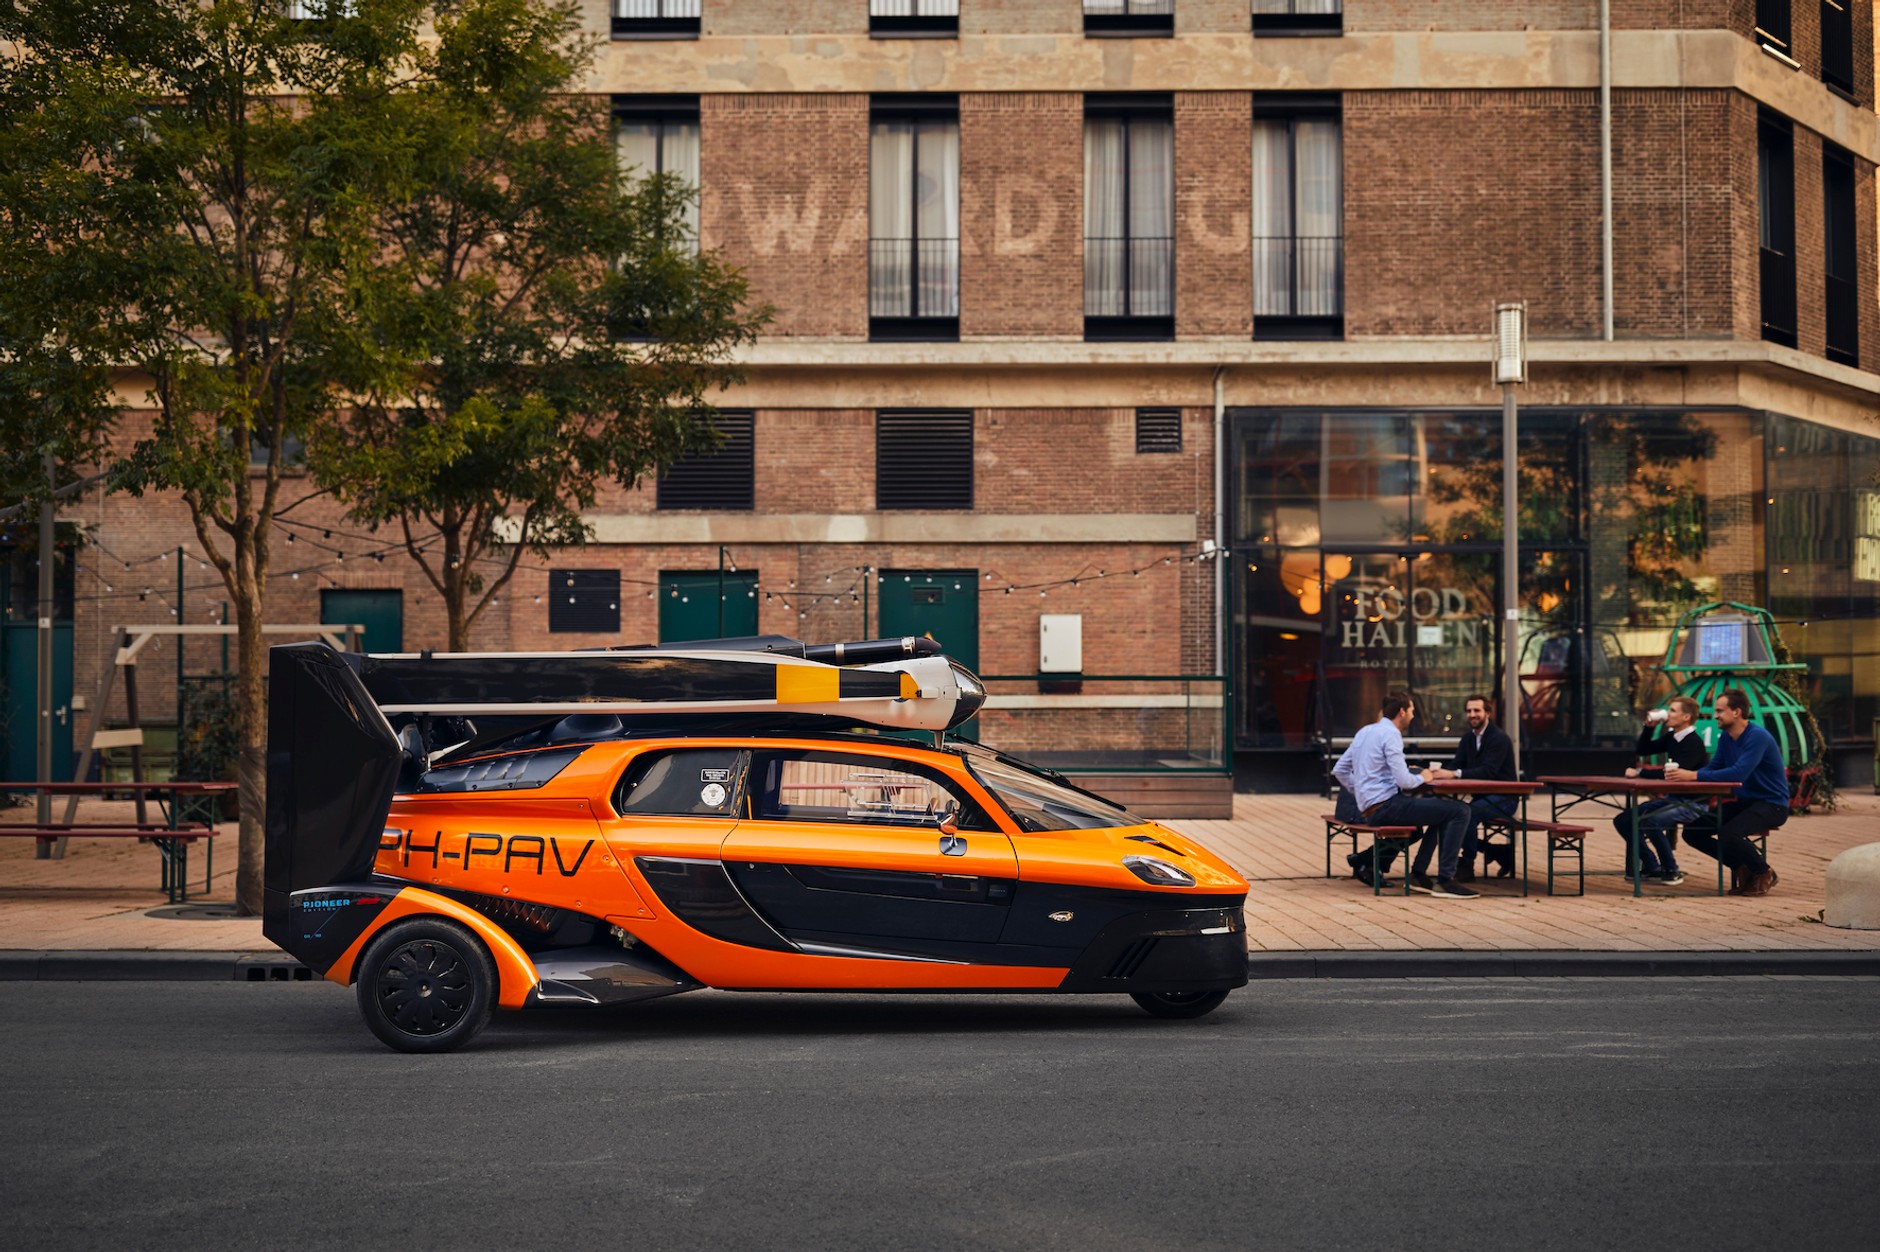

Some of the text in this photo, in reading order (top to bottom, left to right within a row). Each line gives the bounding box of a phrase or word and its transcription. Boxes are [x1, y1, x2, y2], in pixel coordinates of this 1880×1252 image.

[1354, 587, 1467, 621] FOOD
[1341, 620, 1479, 648] HALEN
[303, 899, 350, 909] PIONEER
